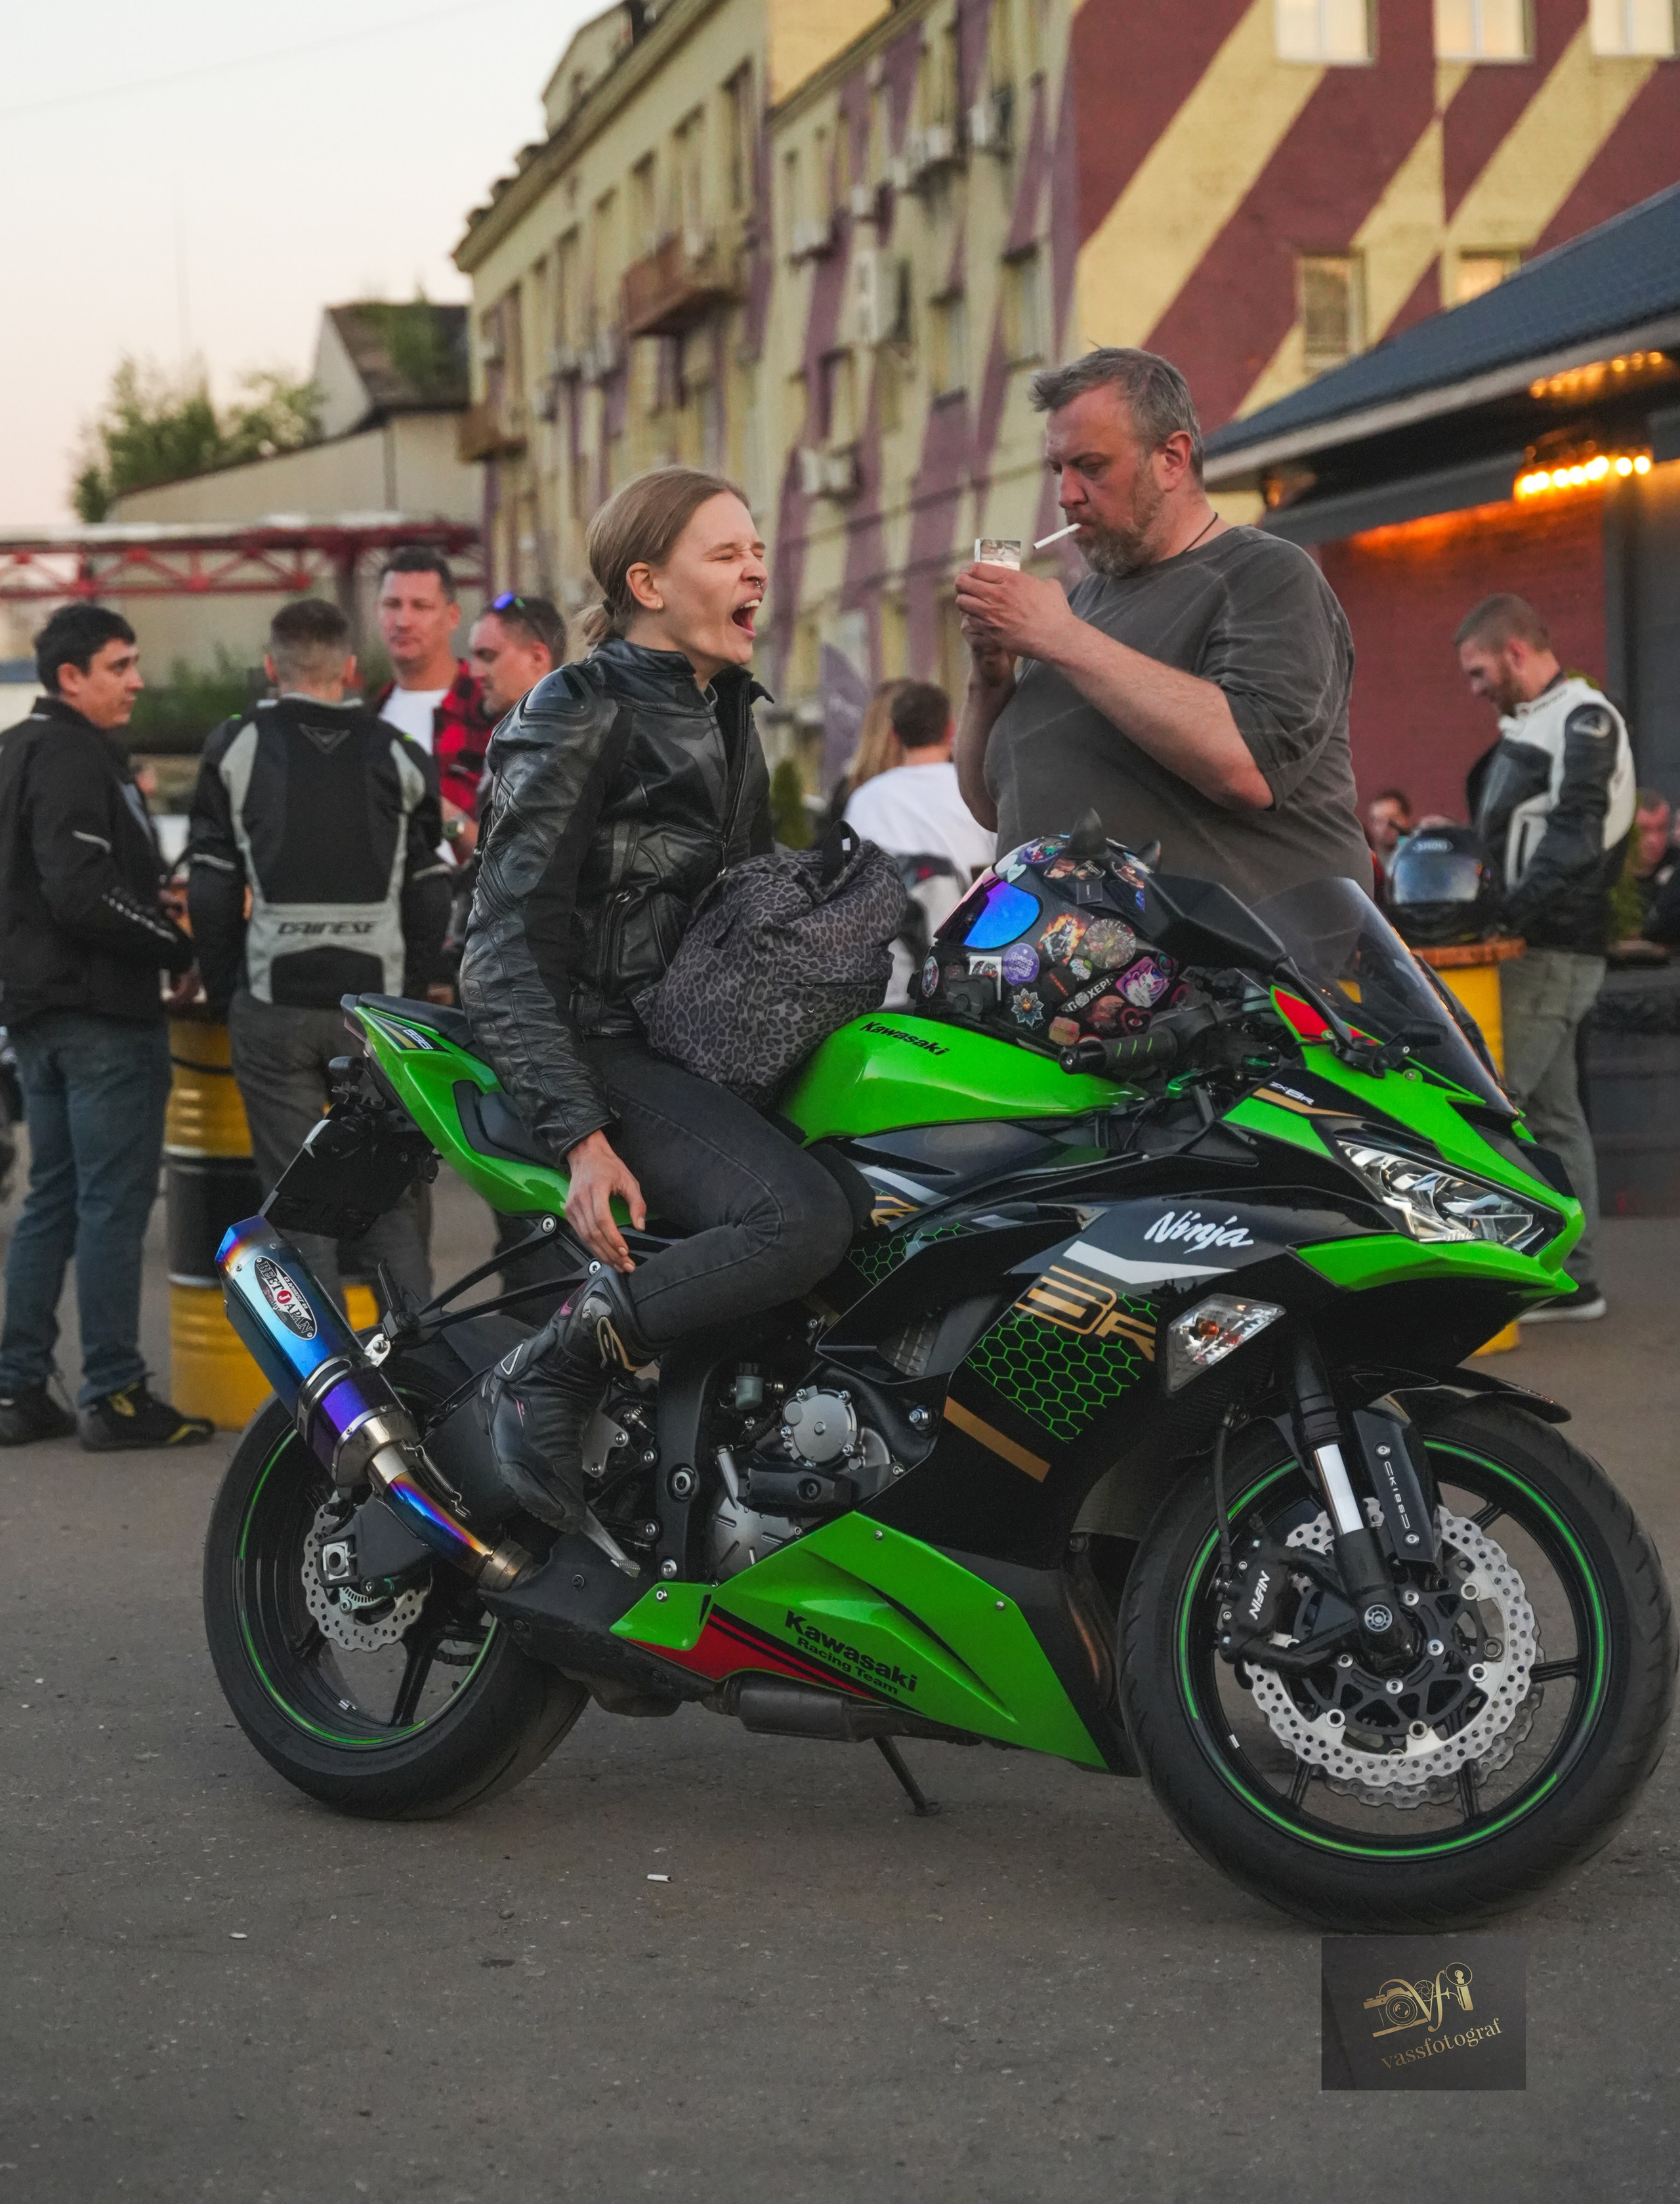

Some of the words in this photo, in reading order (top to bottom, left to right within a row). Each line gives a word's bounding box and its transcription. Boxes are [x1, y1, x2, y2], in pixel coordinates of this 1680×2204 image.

[859, 1021, 950, 1055] Kawasaki
[1144, 1210, 1254, 1254] Ninja
[256, 1260, 285, 1292] BEET
[277, 1290, 314, 1334] JAPAN
[785, 1610, 917, 1692] Kawasaki
[797, 1636, 851, 1672] Racing
[854, 1665, 898, 1695] Team
